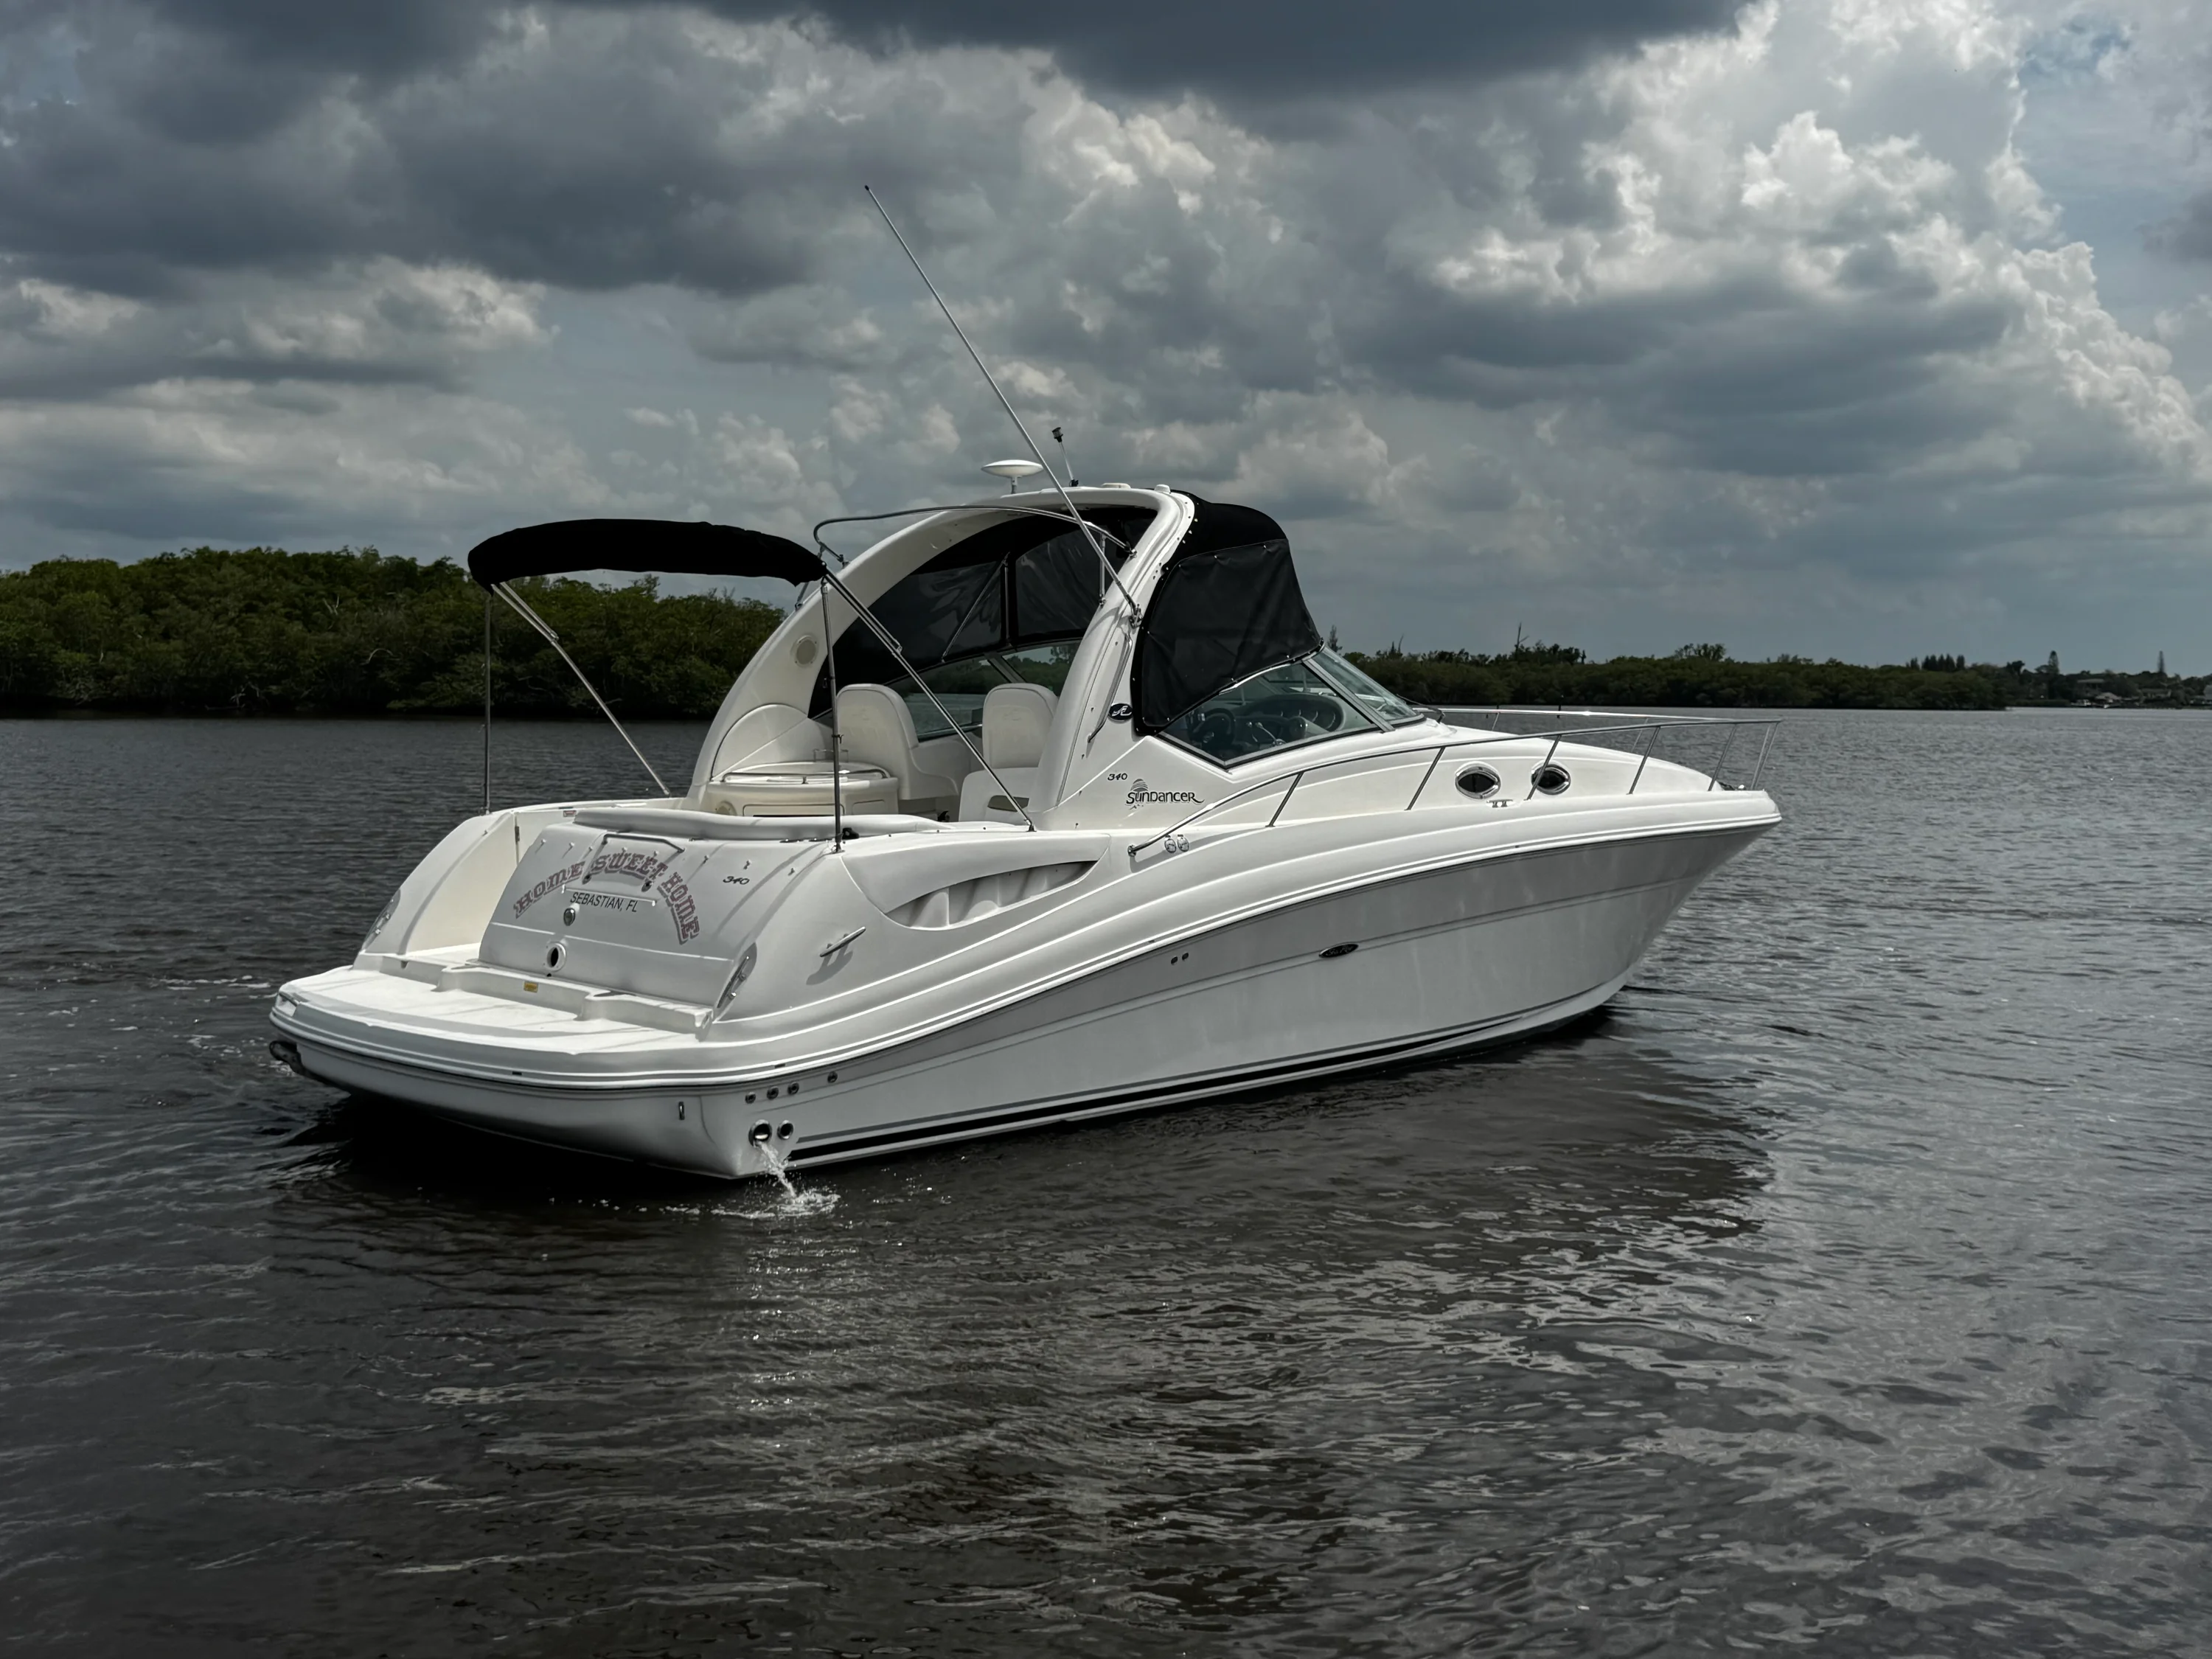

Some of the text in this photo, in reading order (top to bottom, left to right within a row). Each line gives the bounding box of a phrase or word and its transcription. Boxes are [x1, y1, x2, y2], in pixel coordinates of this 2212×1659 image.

[1107, 772, 1128, 782] 340
[723, 875, 751, 886] 340
[513, 852, 700, 945] HOME SWEET HOME
[570, 891, 639, 913] SEBASTIAN, FL
